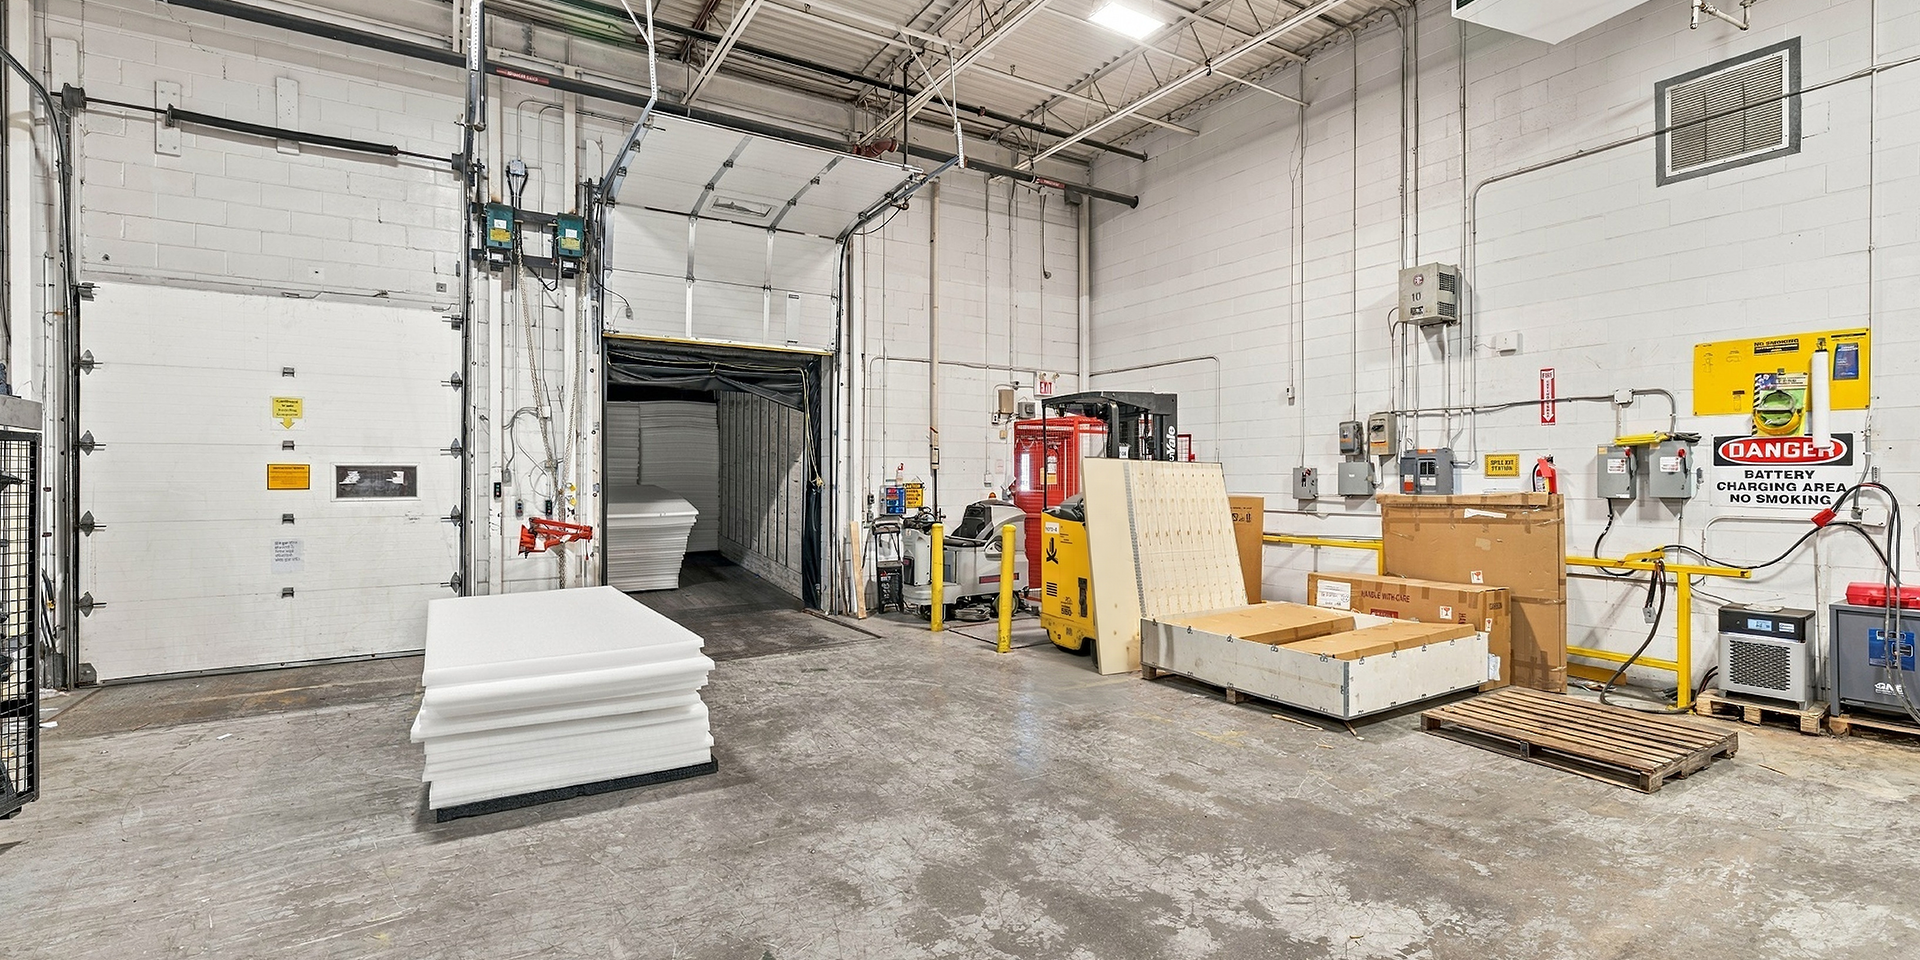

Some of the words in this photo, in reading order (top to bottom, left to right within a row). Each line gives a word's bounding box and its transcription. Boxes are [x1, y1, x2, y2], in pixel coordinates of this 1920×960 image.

[1412, 292, 1421, 301] 10
[1040, 381, 1052, 394] EXIT
[1166, 425, 1176, 455] Yale
[1729, 442, 1836, 458] DANGER
[1745, 470, 1815, 479] BATTERY
[1716, 482, 1797, 492] CHARGING
[1802, 483, 1847, 492] AREA
[1730, 494, 1751, 503] NO
[1756, 494, 1832, 505] SMOKING
[1396, 594, 1410, 603] CARE
